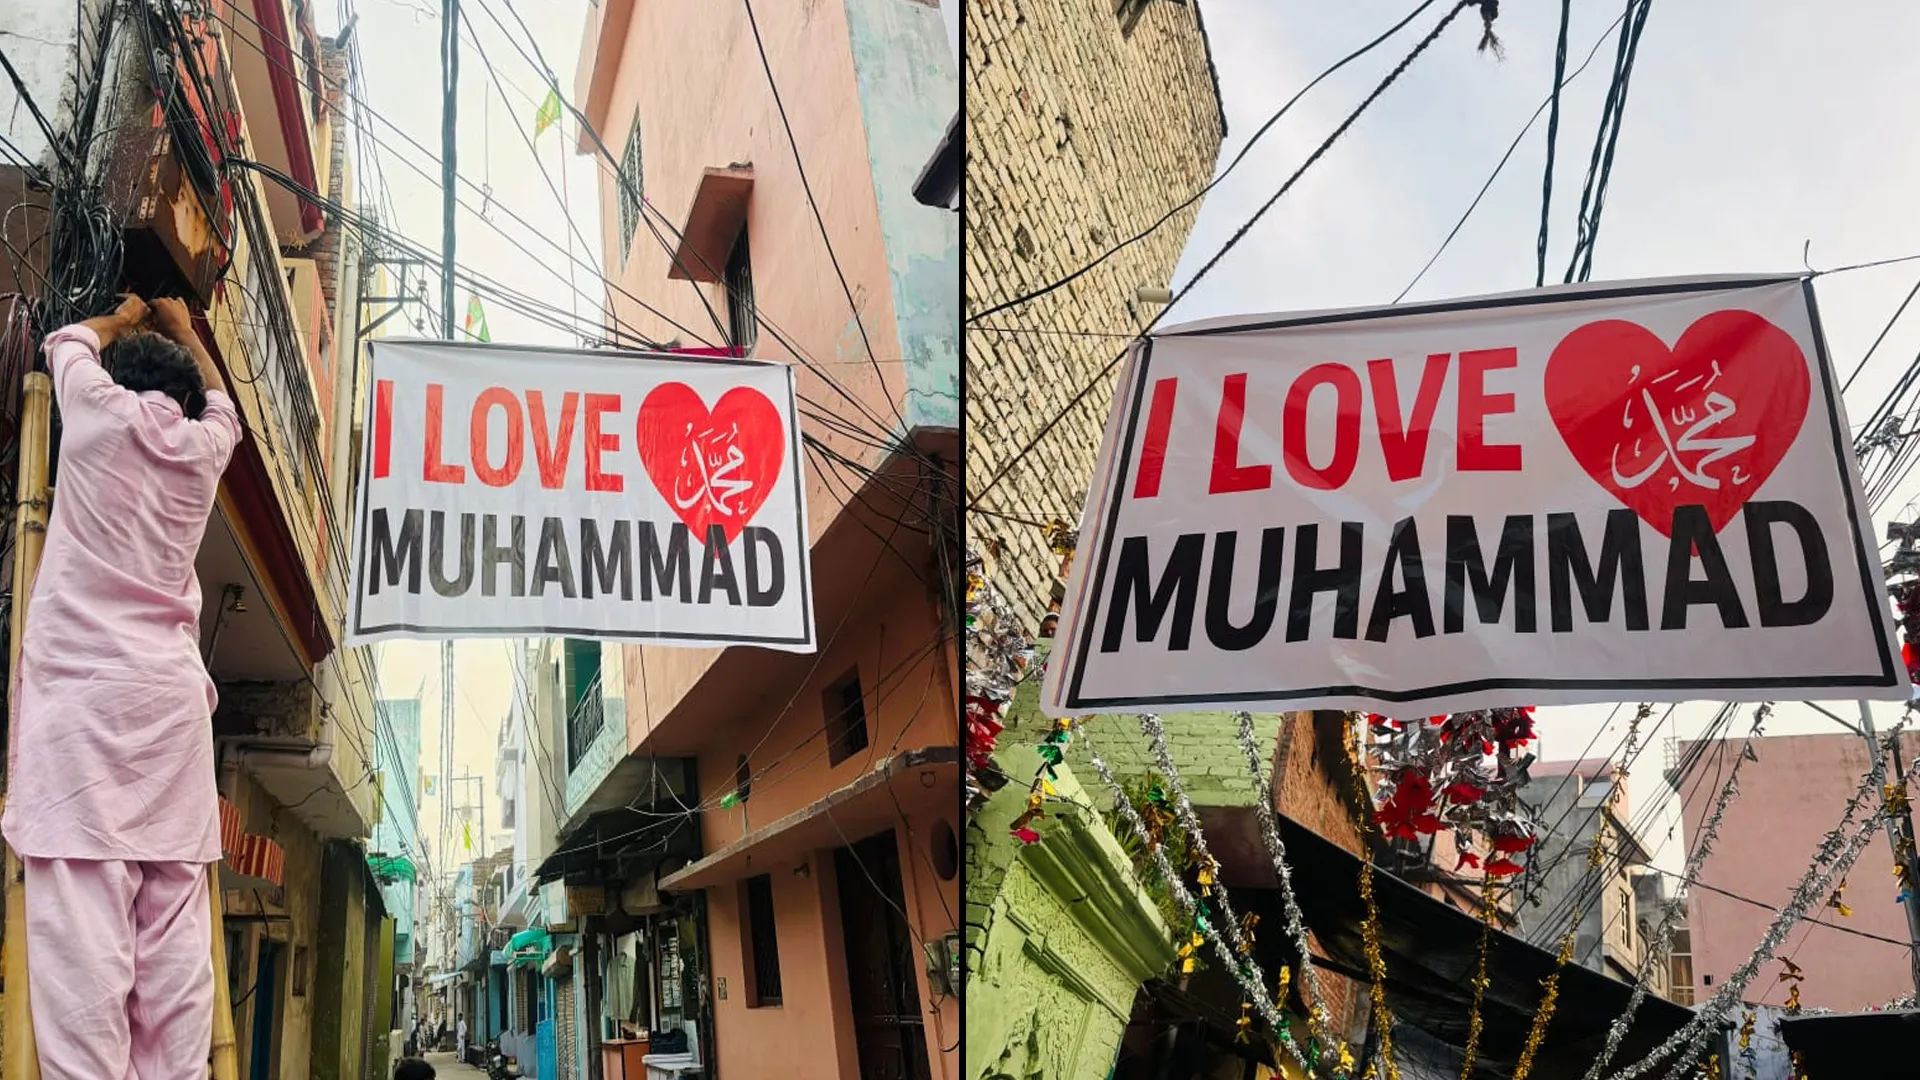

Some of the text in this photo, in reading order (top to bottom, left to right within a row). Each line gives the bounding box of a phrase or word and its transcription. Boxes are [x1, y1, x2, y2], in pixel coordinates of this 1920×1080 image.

[373, 379, 624, 494] I LOVE
[1133, 347, 1523, 499] I LOVE
[368, 507, 786, 608] MUHAMMAD
[1099, 499, 1835, 654] MUHAMMAD
